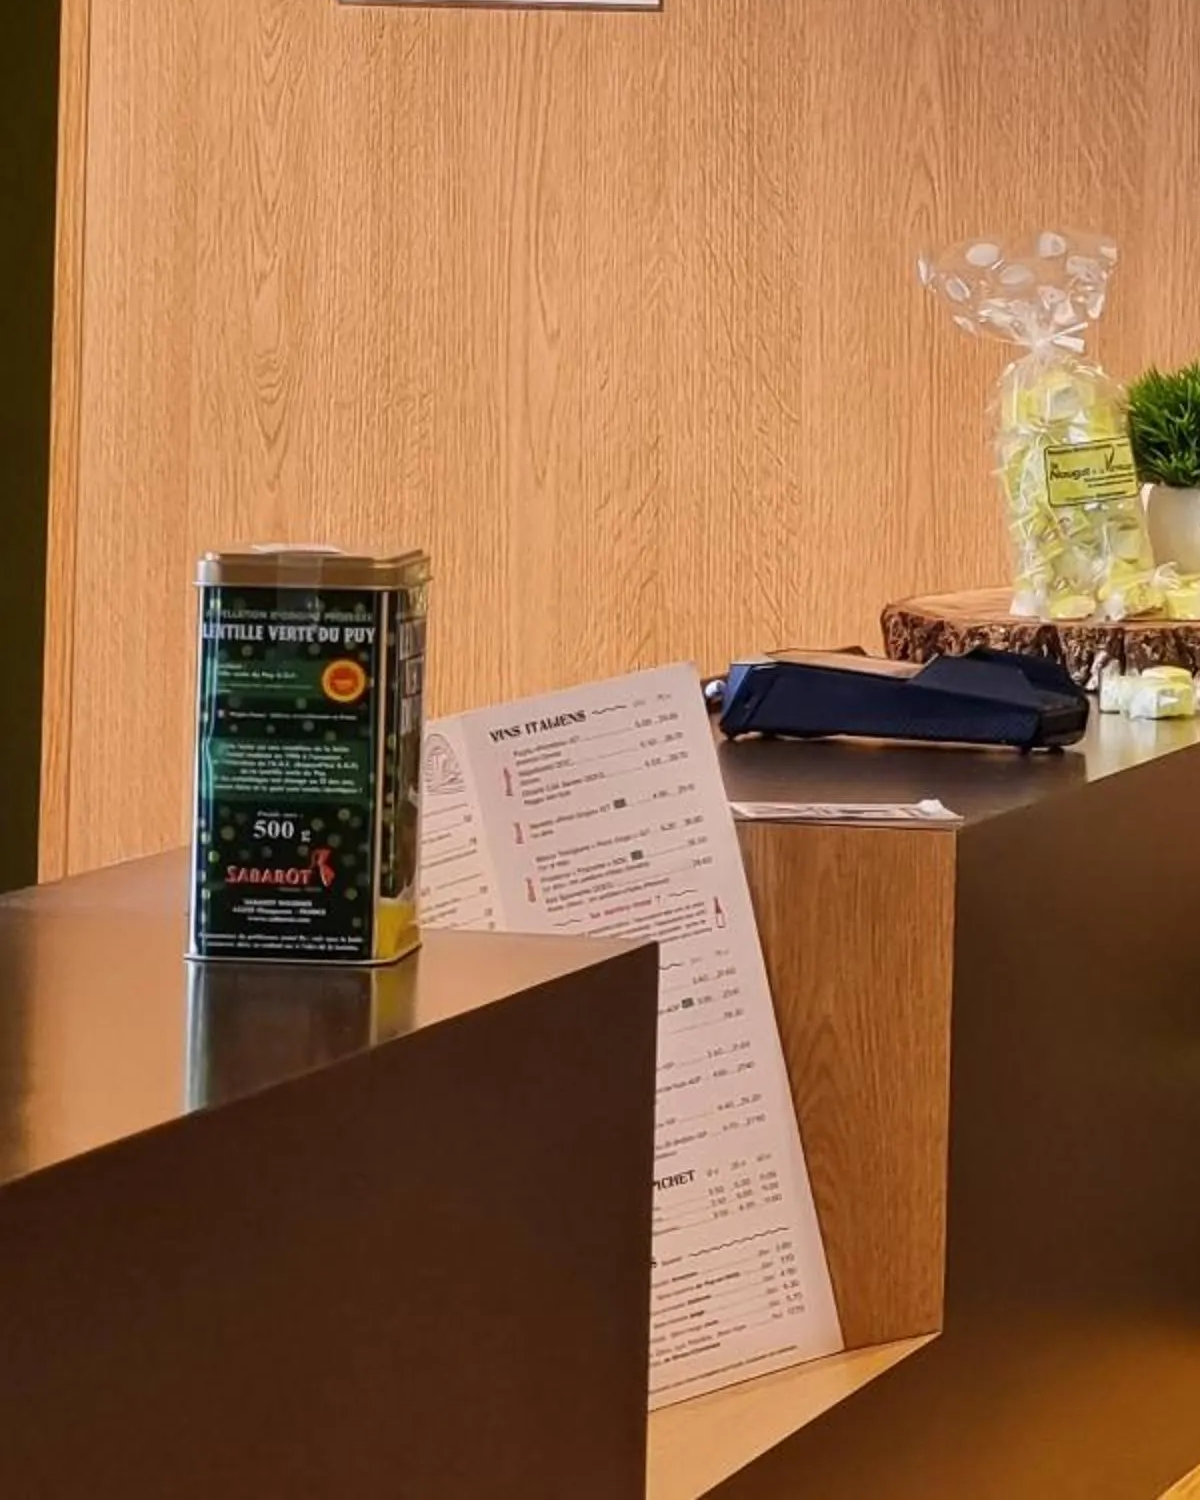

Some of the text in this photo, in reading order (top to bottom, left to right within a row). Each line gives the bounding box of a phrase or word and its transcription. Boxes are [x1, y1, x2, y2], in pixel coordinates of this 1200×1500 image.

[317, 626, 340, 643] DU
[343, 627, 377, 644] PUY
[489, 710, 587, 743] VINS ITALIENS
[253, 819, 312, 843] 500 g
[225, 864, 313, 885] SABAROT
[653, 1168, 696, 1191] ICHET
